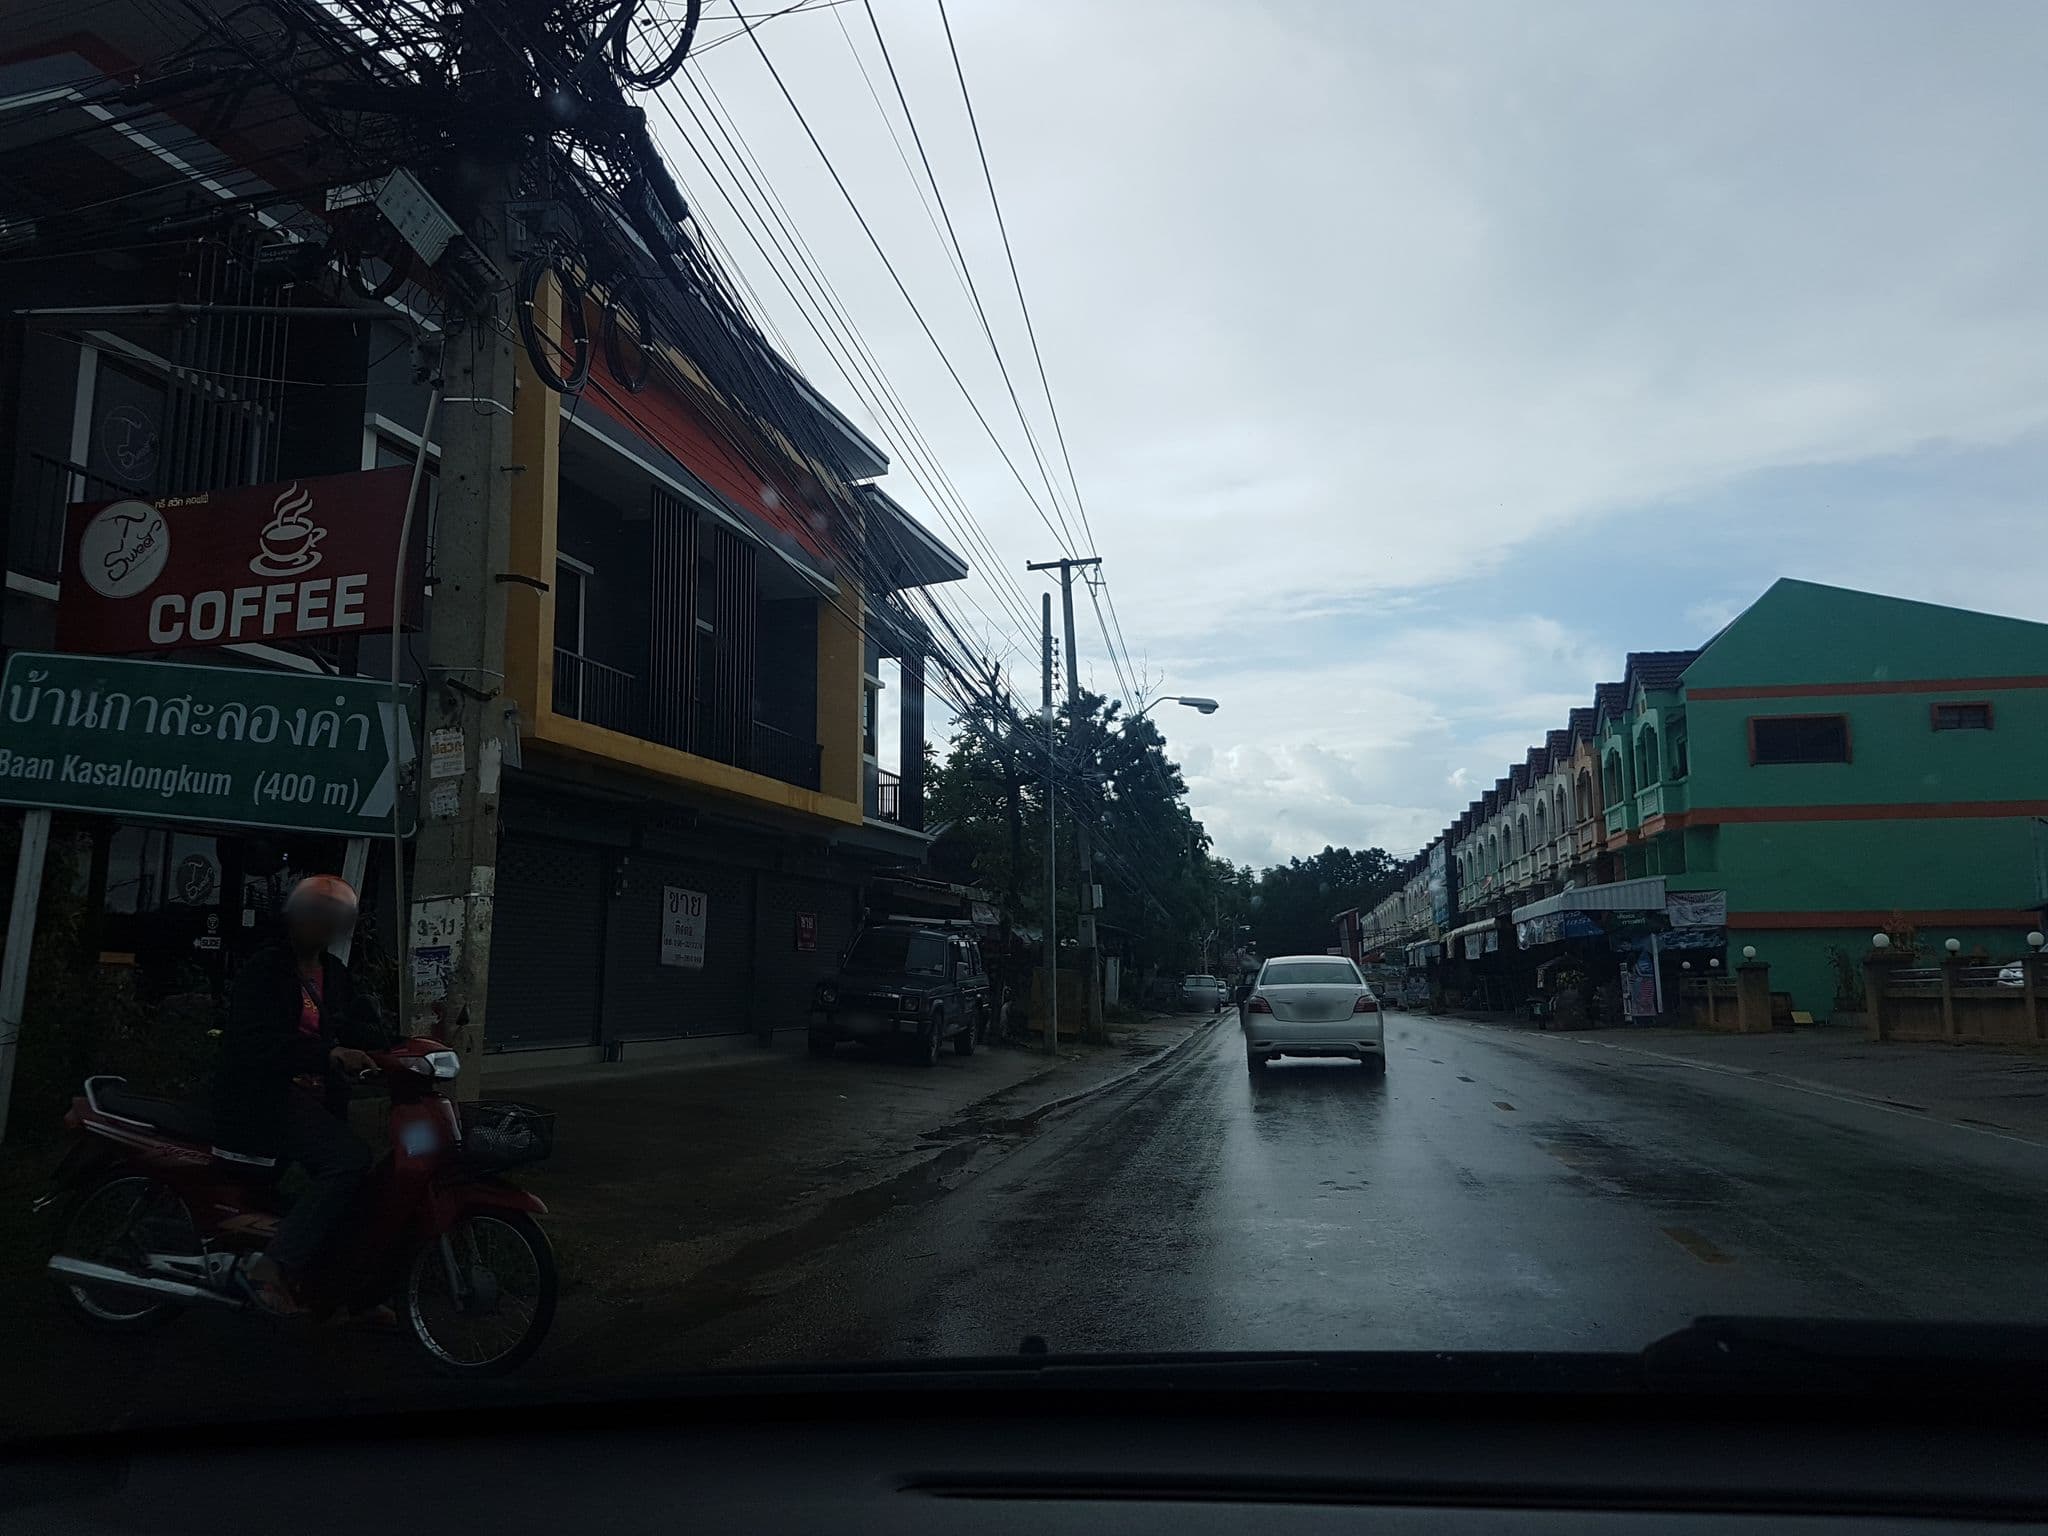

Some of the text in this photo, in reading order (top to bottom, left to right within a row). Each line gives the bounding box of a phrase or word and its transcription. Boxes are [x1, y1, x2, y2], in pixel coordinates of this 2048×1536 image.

[148, 573, 368, 645] COFFEE
[8, 669, 371, 752] บ้านกาสะลองคำ
[0, 748, 360, 814] Baan Kasalongkum (400 m)
[669, 891, 702, 918] ขาย
